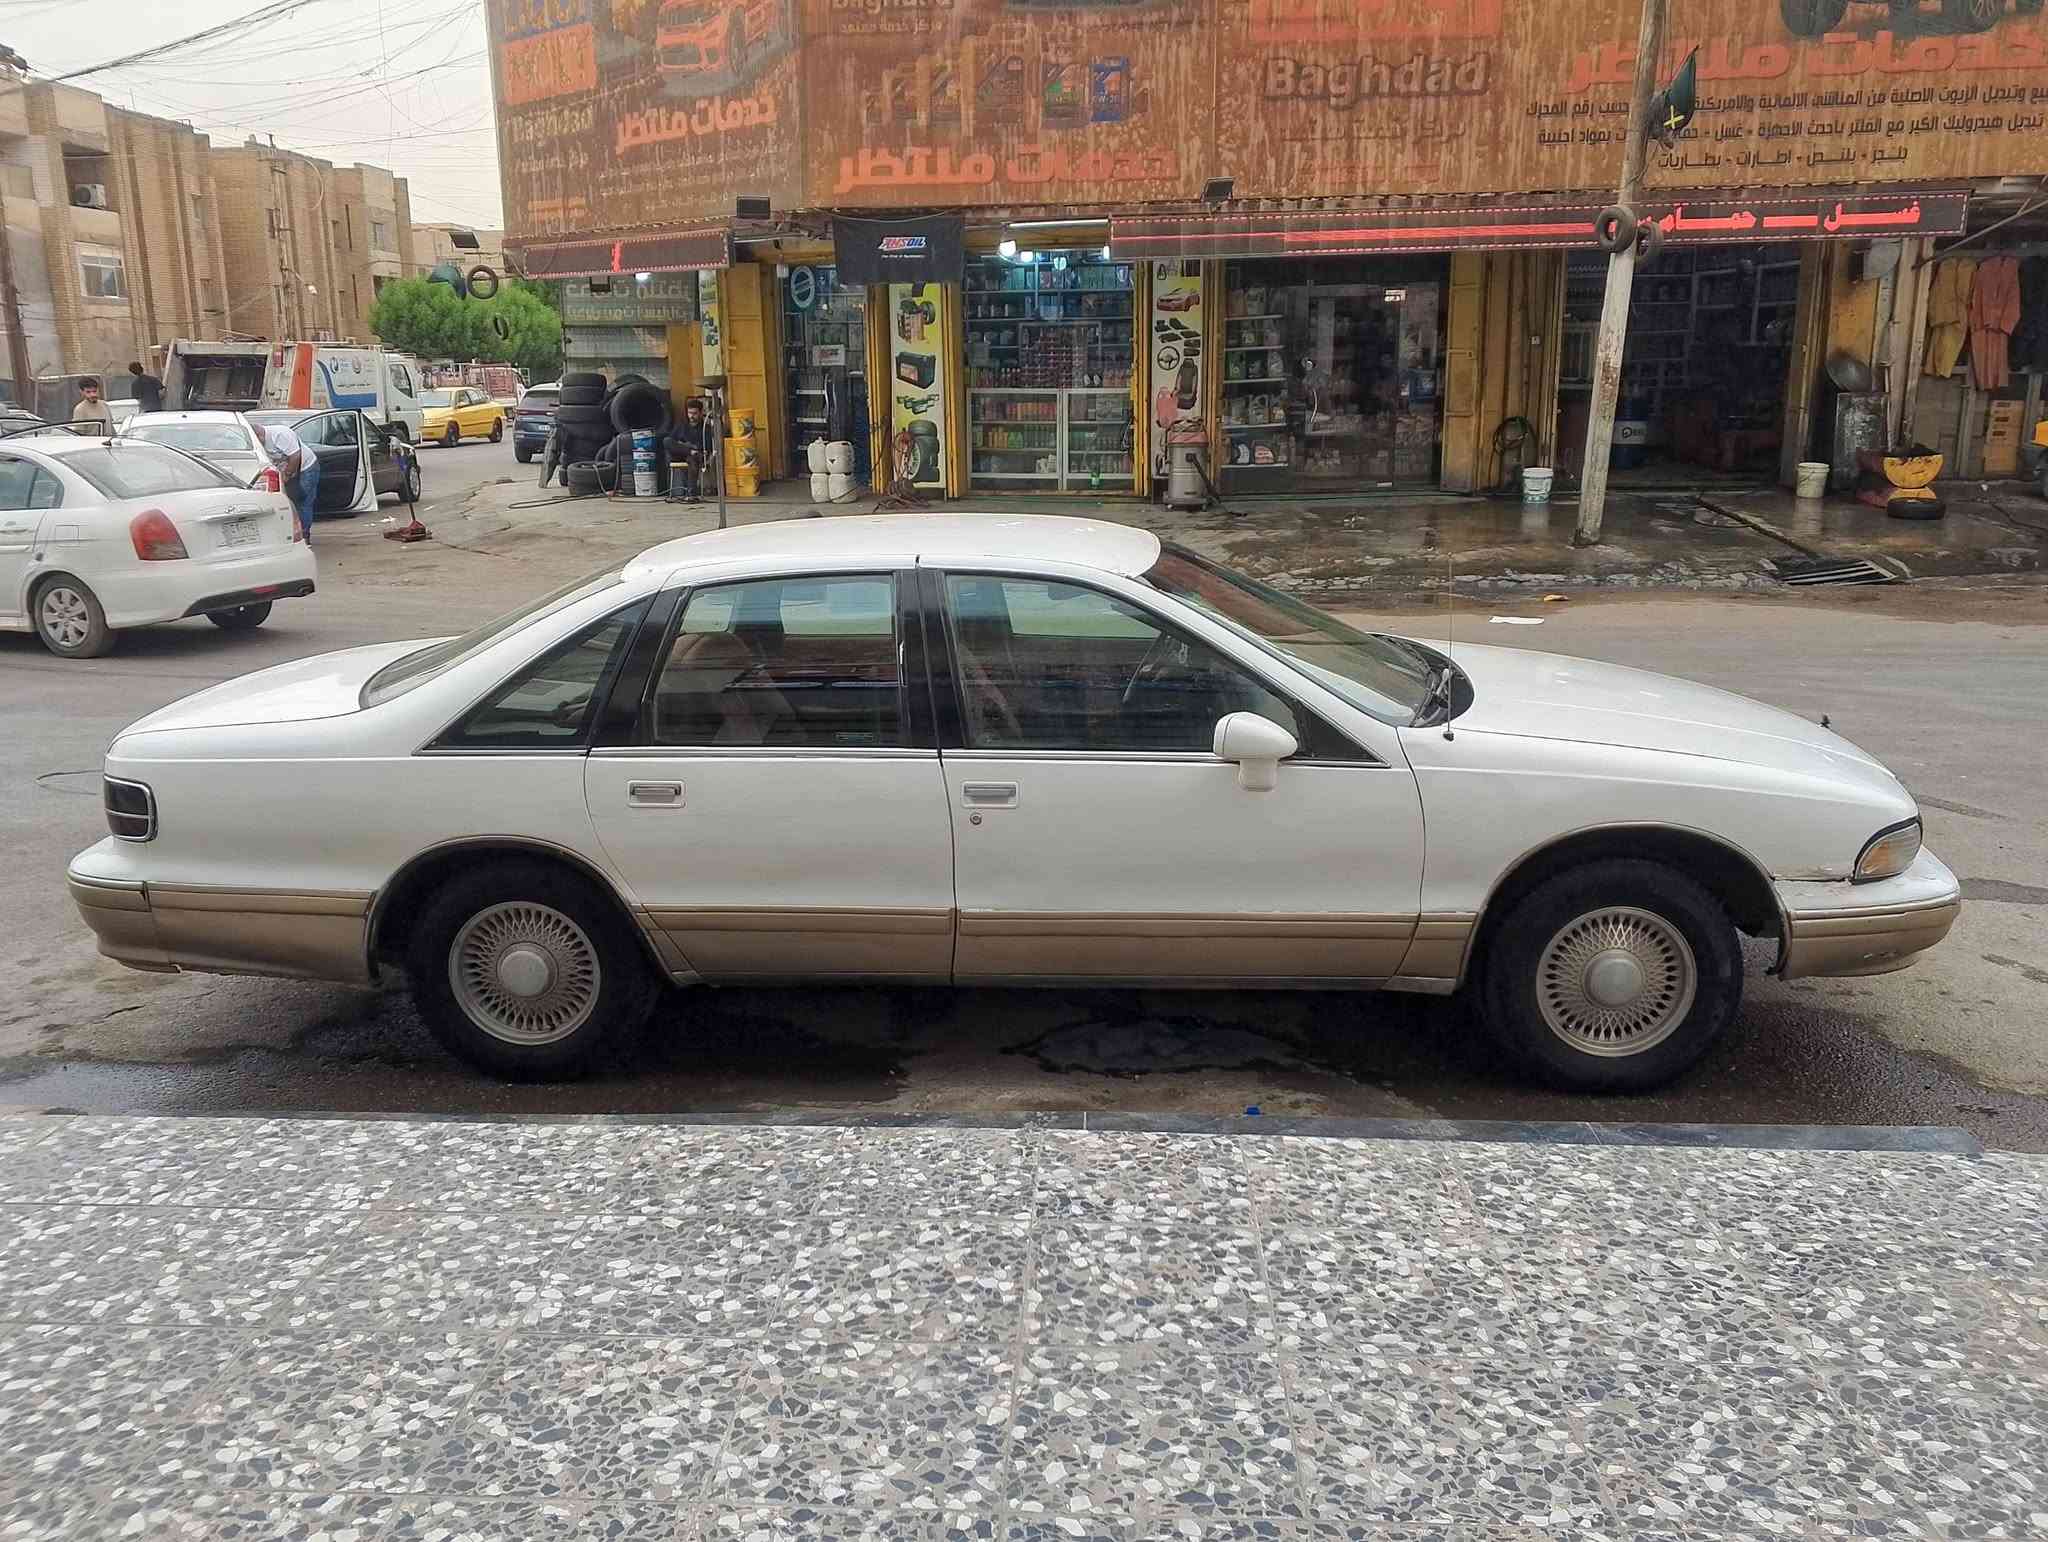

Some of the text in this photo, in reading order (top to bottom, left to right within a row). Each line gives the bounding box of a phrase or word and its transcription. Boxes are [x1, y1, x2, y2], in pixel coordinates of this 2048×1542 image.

[1808, 25, 2046, 76] خدمات
[1264, 52, 1491, 109] Baghdad
[1867, 90, 1887, 107] من
[1939, 84, 1978, 104] الزيوت
[1983, 83, 2025, 104] وتبديل
[1526, 100, 1567, 118] المحرك
[1572, 100, 1594, 118] رقم
[1715, 121, 1743, 141] غسل
[1887, 118, 1905, 137] مع
[1944, 114, 2002, 133] هيدروليك
[2008, 112, 2043, 132] تبديل
[1007, 143, 1181, 183] خدمات
[879, 236, 927, 251] AMSOIL
